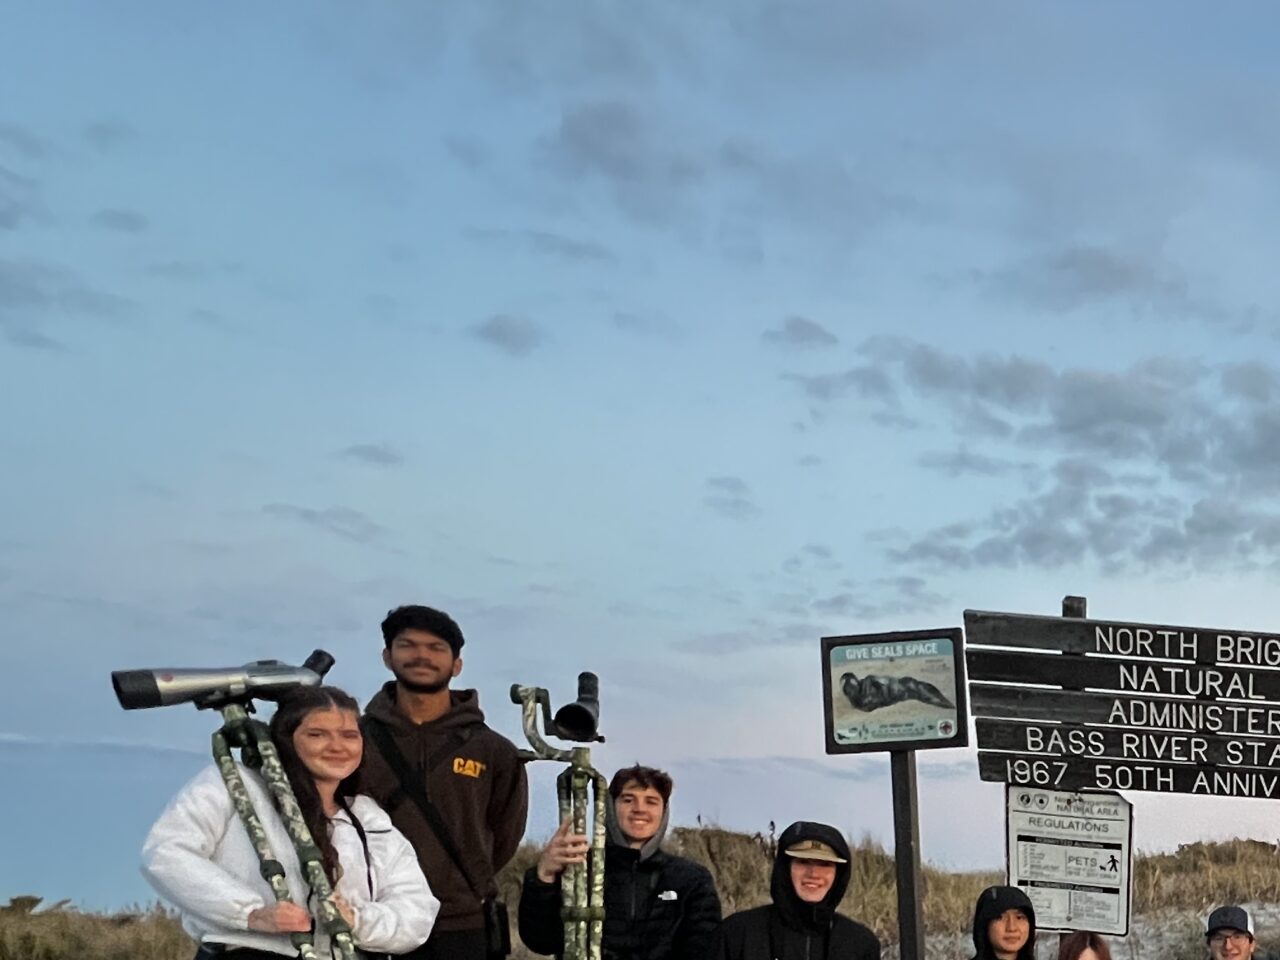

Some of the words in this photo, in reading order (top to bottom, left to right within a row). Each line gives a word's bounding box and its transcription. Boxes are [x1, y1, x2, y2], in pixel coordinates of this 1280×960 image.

[845, 646, 869, 660] GIVE
[871, 645, 903, 658] SEALS
[905, 642, 938, 656] SPACE
[1095, 626, 1198, 660] NORTH
[1119, 664, 1266, 700] NATURAL
[1026, 727, 1105, 756] BASS
[1122, 733, 1208, 762] RIVER
[453, 757, 481, 778] CAT
[1006, 759, 1068, 785] 1967
[1095, 764, 1174, 791] 50TH
[1028, 817, 1109, 833] REGULATIONS
[1068, 855, 1098, 867] PETS
